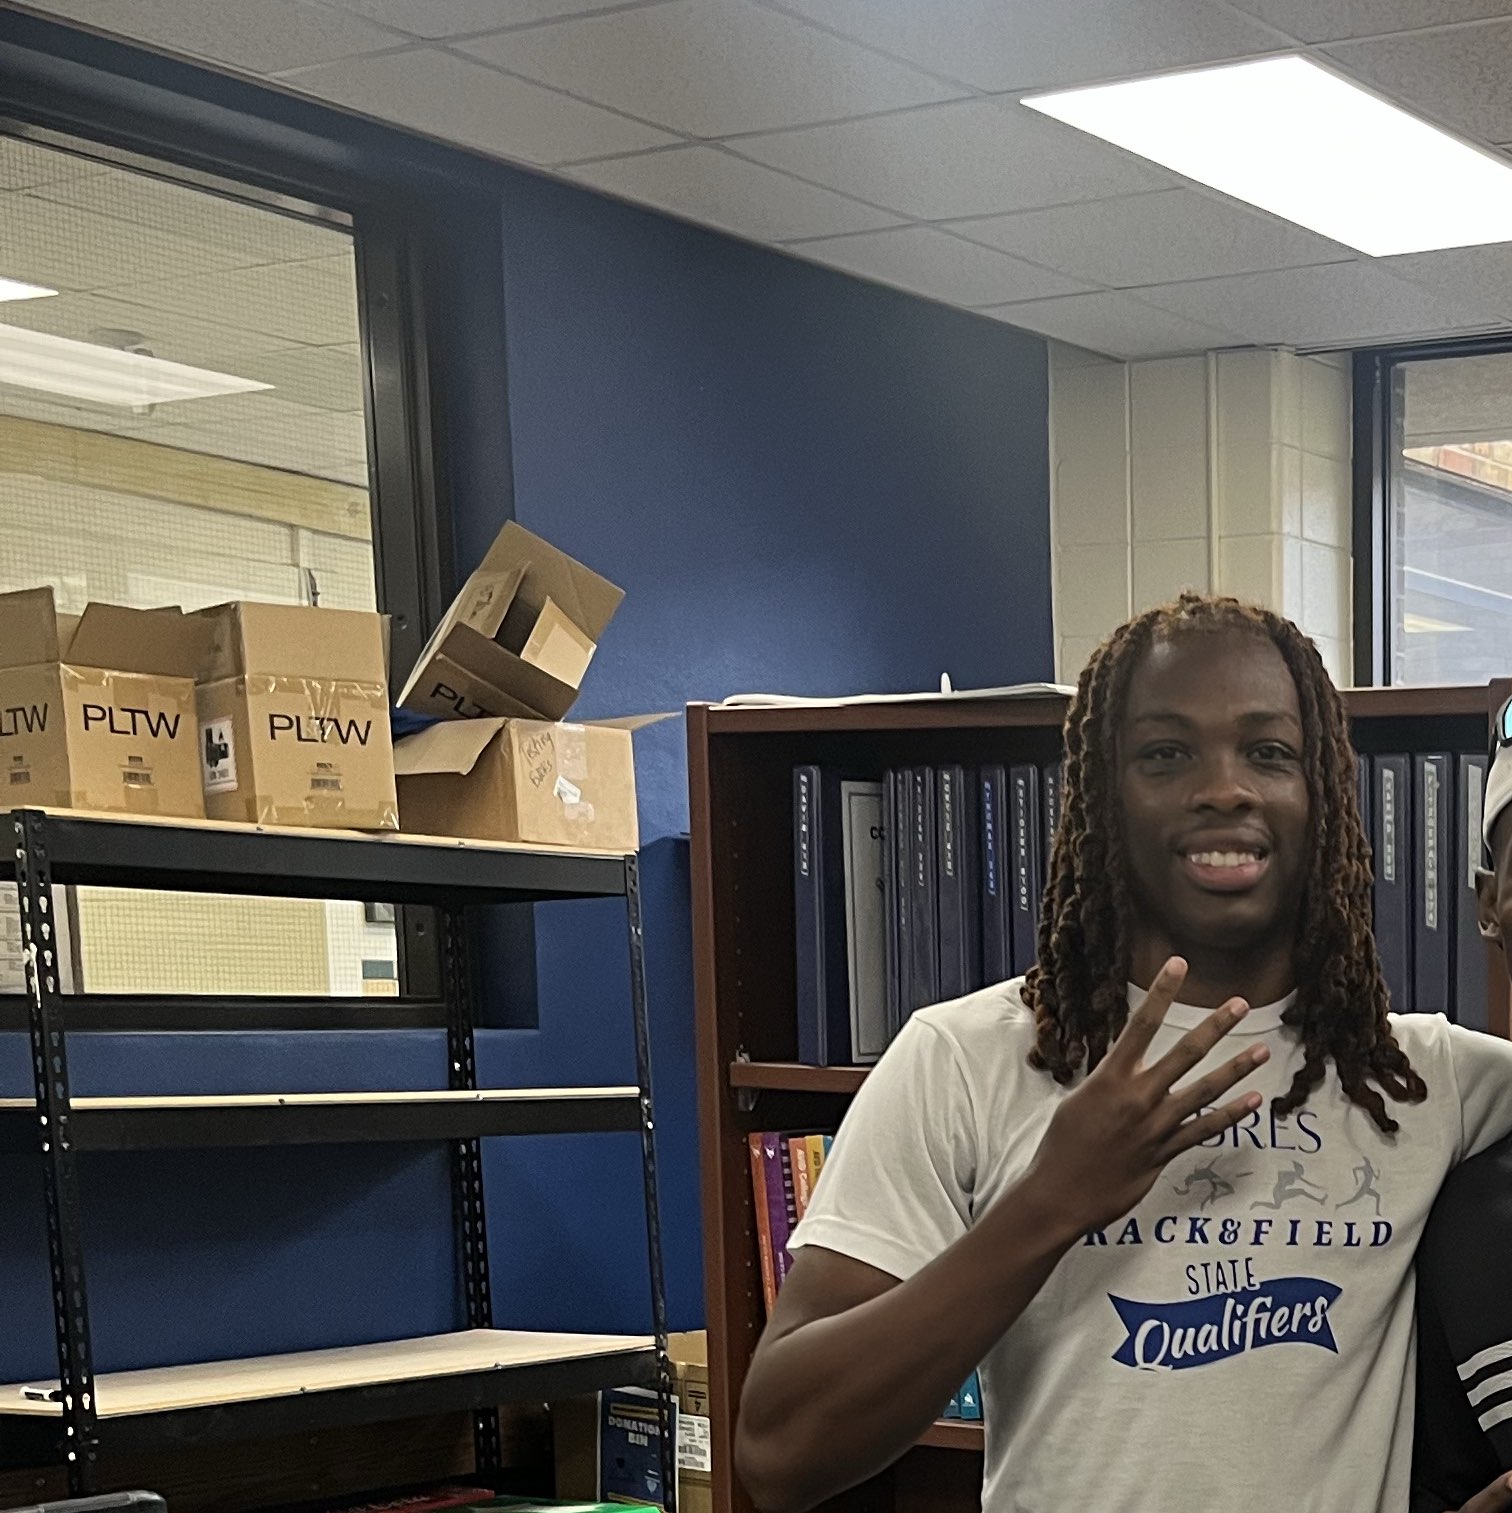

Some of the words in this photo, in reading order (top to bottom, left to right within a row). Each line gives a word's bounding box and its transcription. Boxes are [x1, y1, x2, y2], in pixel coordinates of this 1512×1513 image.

[83, 703, 180, 739] PLTW
[269, 713, 372, 746] PLTW
[1186, 1257, 1256, 1295] STATE
[1134, 1295, 1330, 1372] Qualifiers
